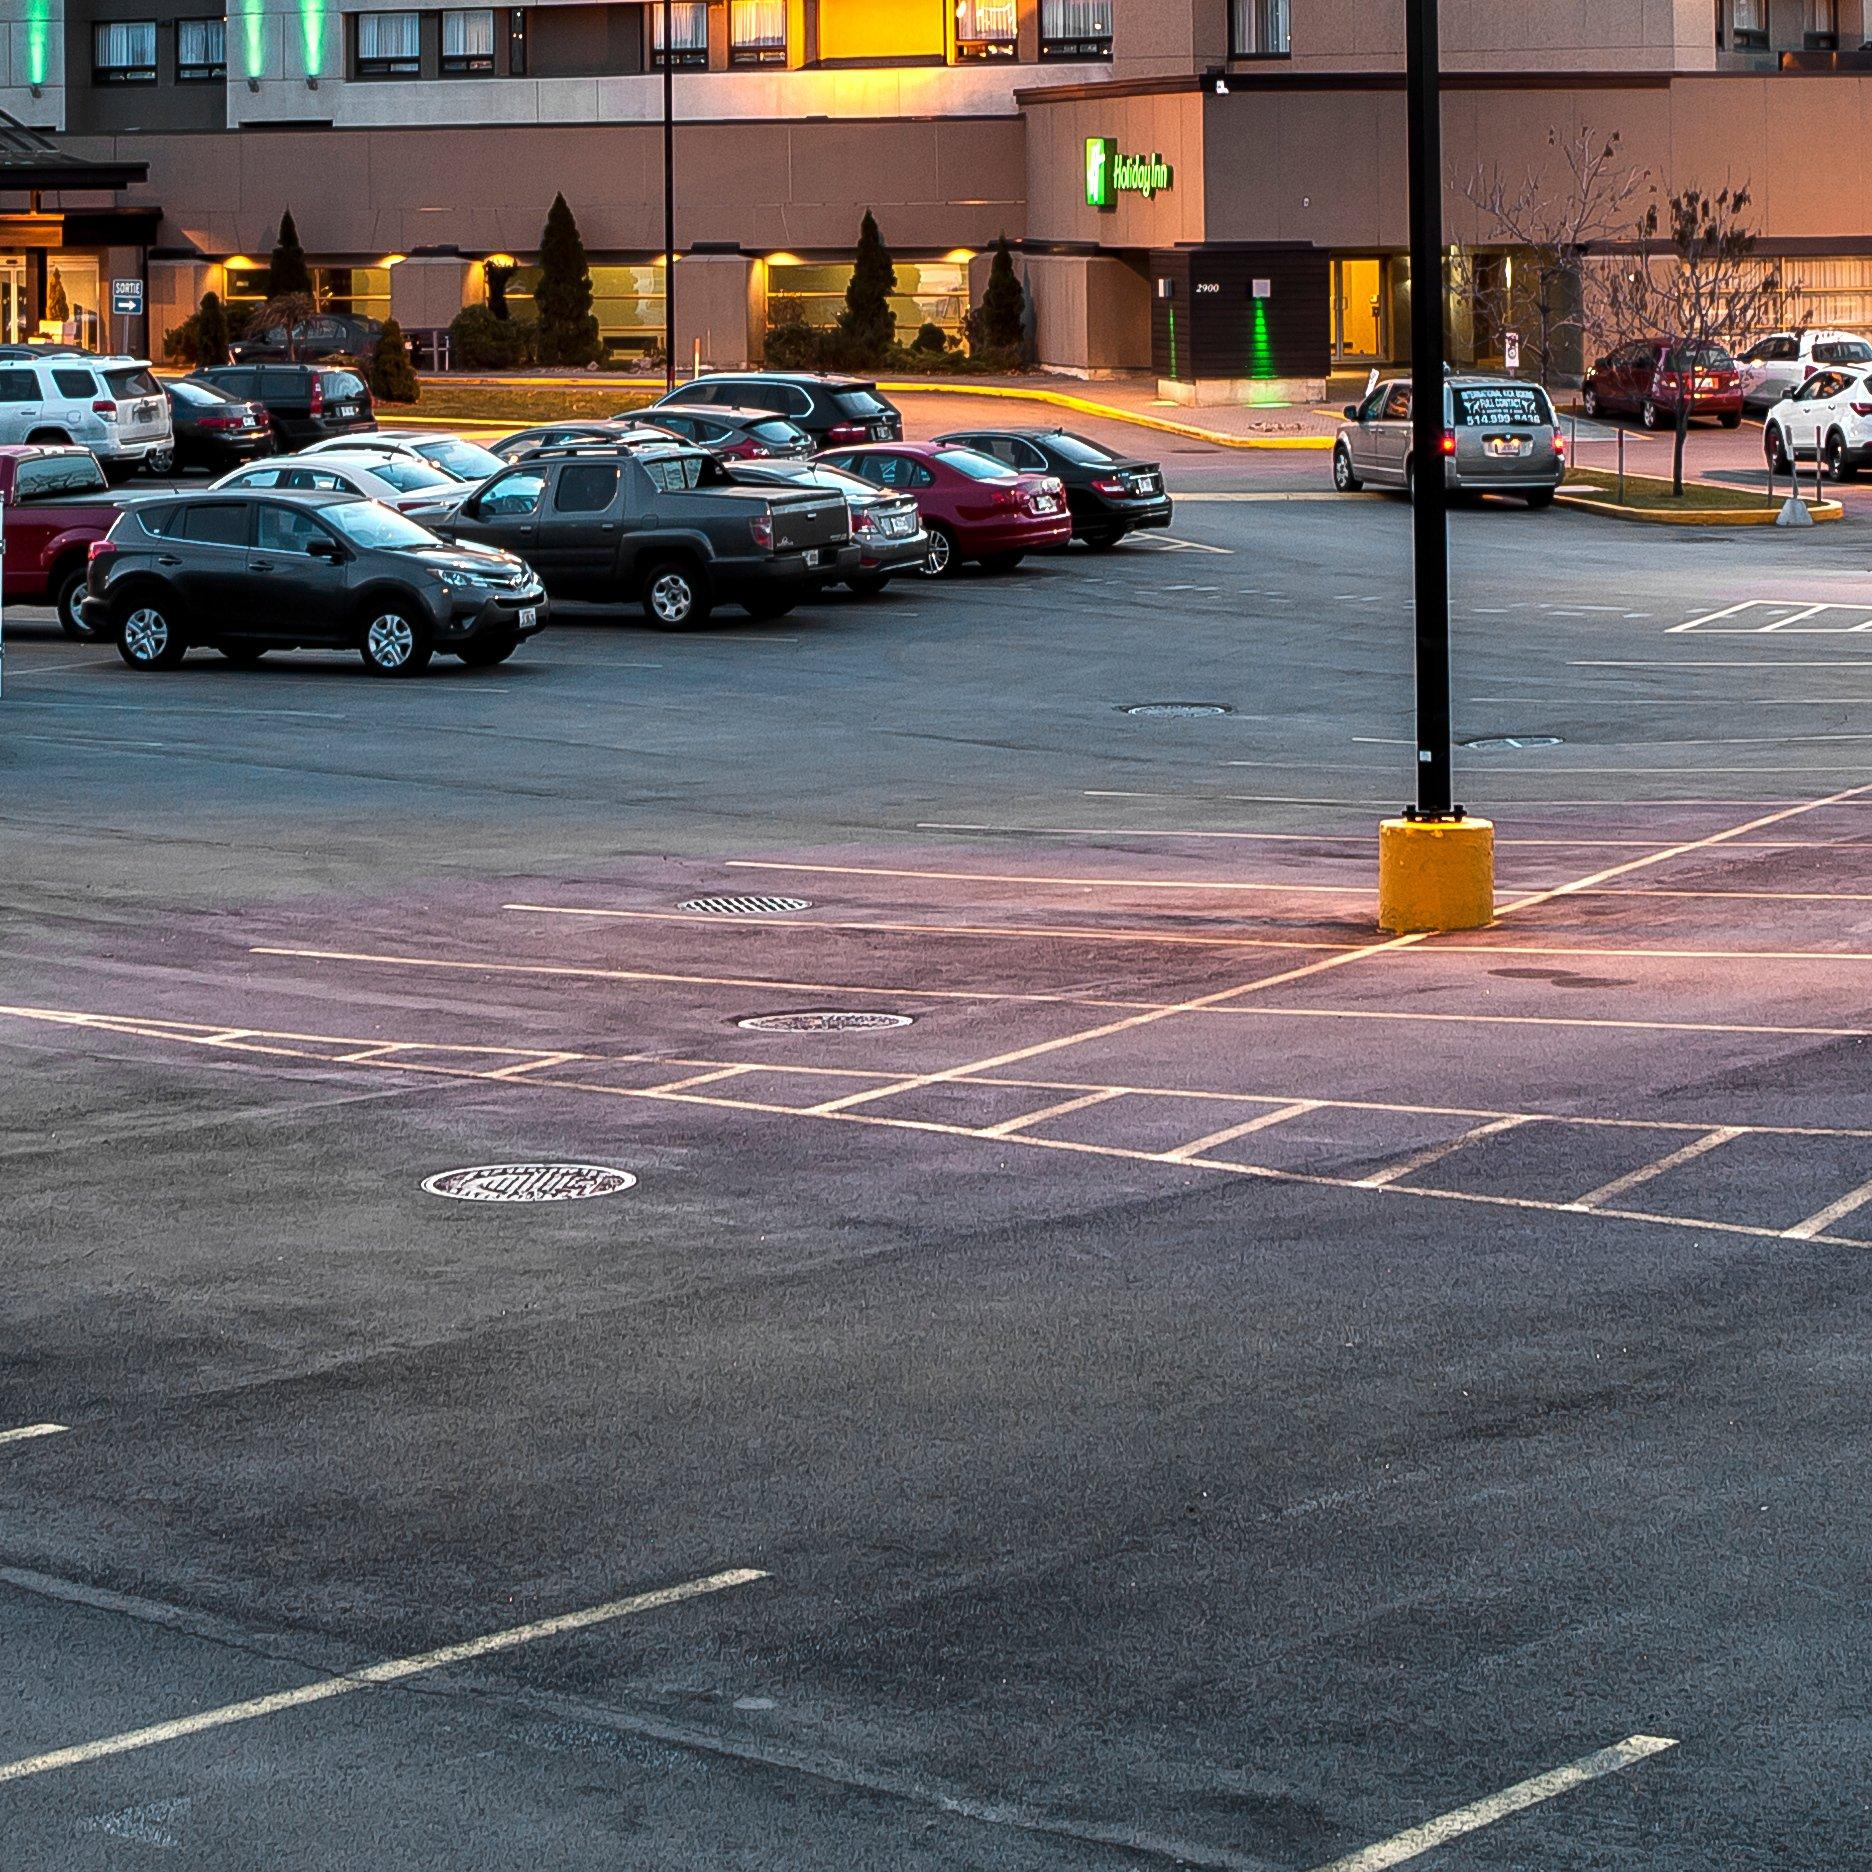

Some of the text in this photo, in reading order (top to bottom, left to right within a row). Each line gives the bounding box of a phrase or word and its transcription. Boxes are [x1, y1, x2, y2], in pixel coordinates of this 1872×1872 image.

[1113, 152, 1168, 198] Holiday Inn
[115, 282, 140, 294] SORTIE
[1195, 283, 1220, 293] 2900
